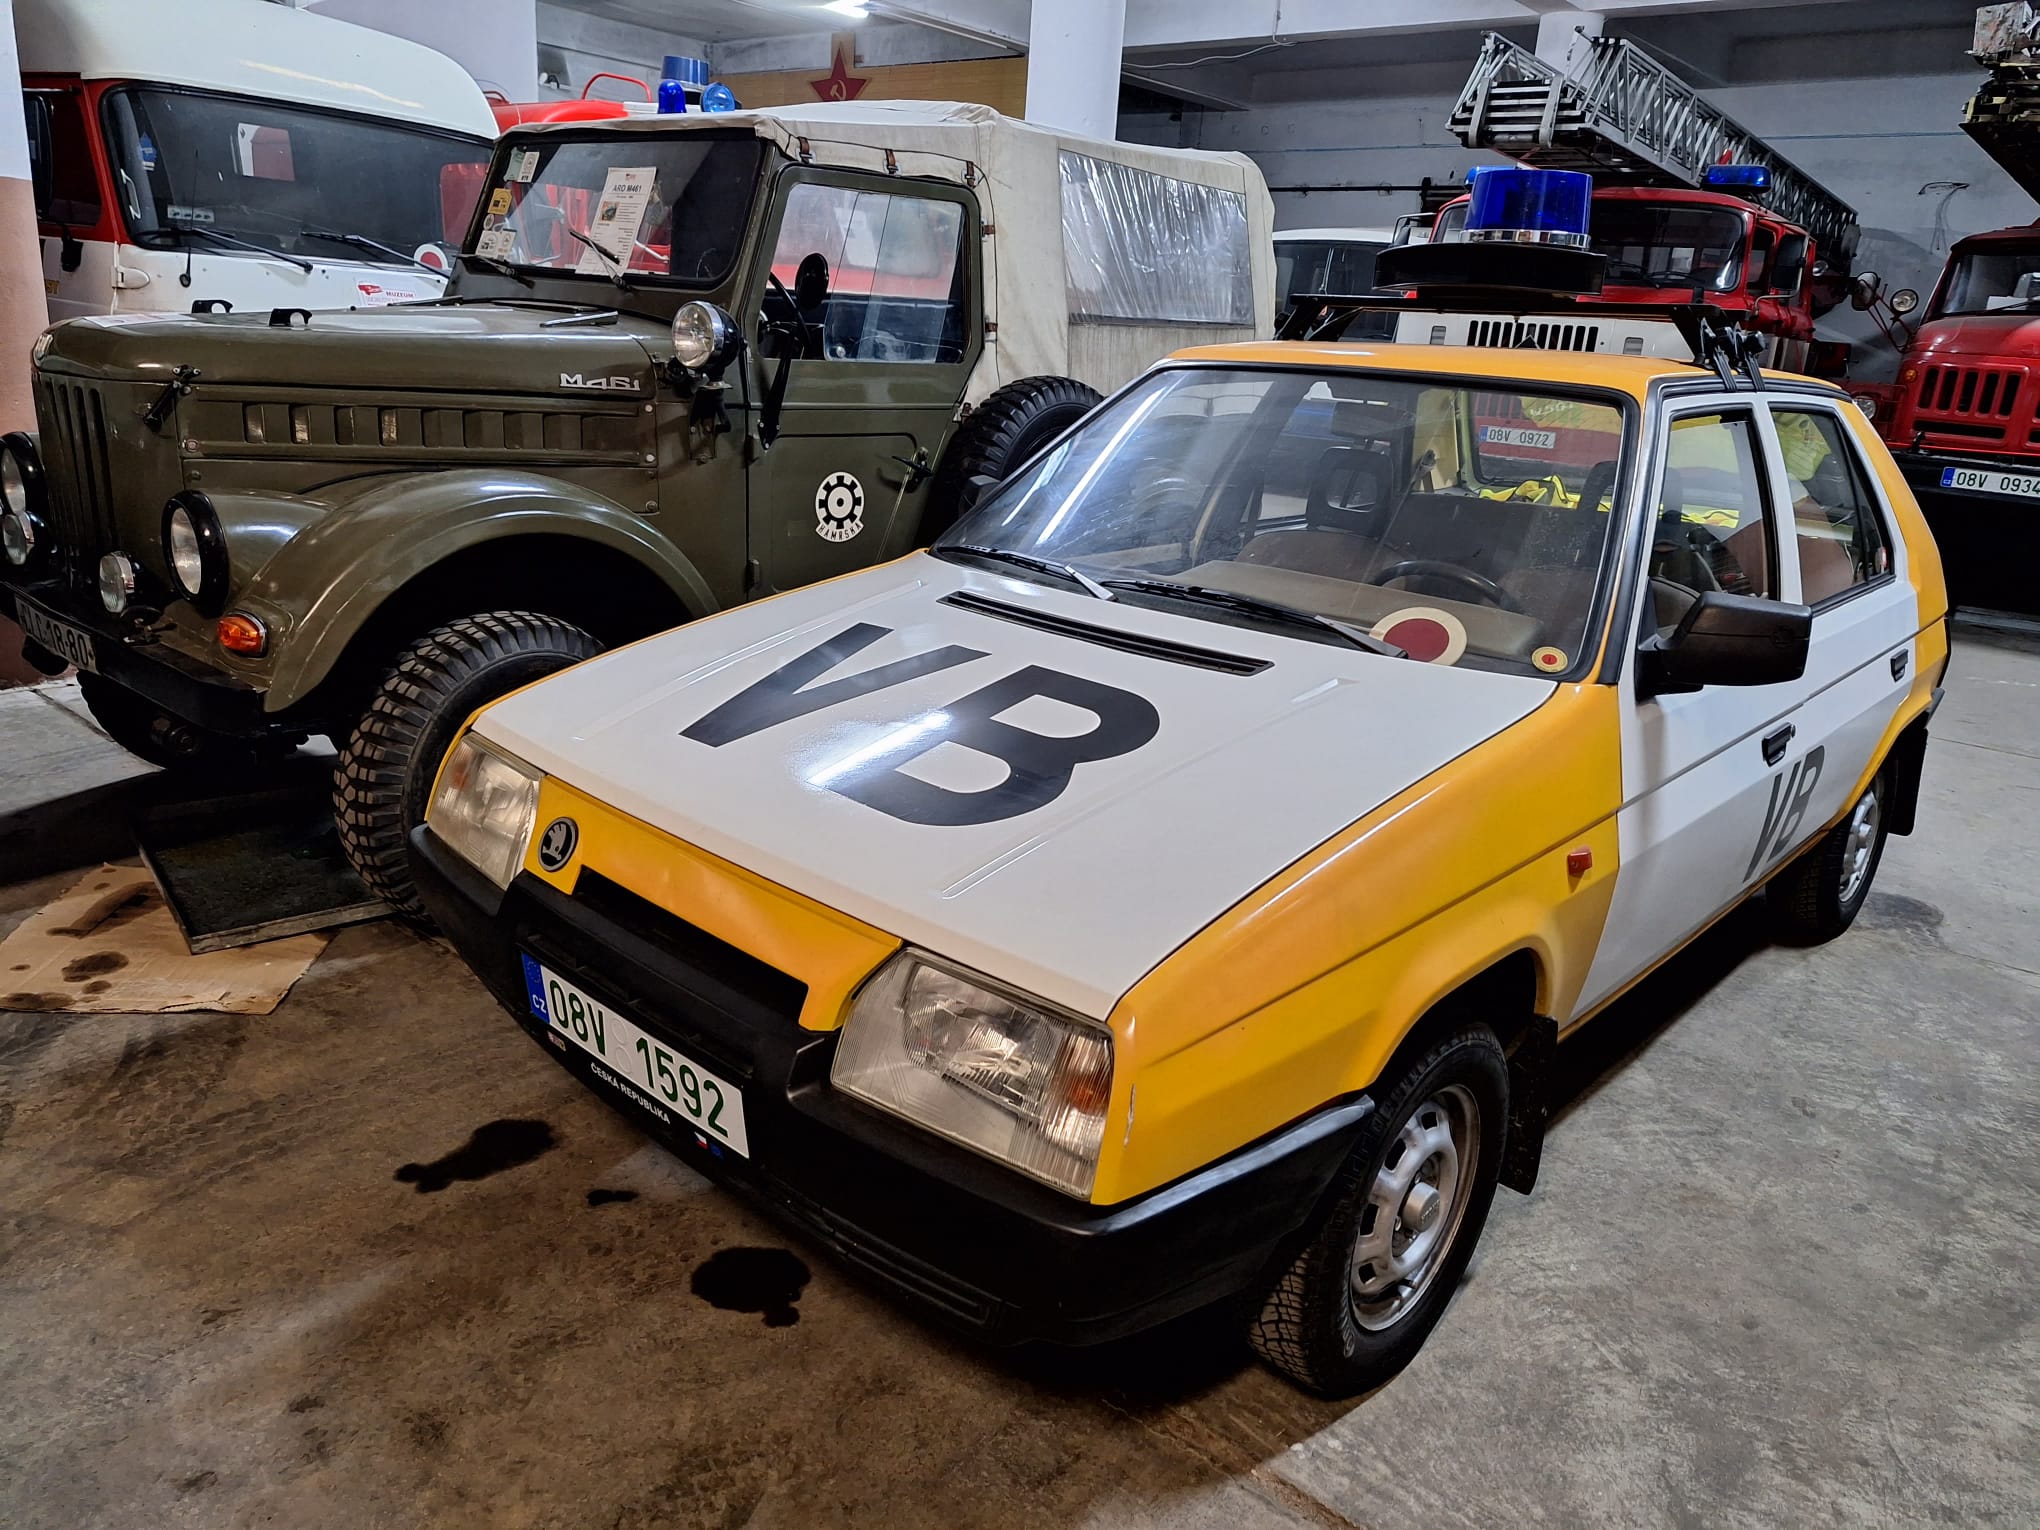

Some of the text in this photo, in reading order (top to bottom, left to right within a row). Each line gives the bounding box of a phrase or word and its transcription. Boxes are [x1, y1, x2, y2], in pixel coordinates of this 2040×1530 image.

[385, 290, 415, 299] MUZEUM
[1489, 428, 1550, 447] 08V 0972
[1956, 471, 2040, 495] 08V 0934
[678, 622, 1160, 826] VB
[1743, 744, 1826, 884] VB
[532, 994, 547, 1014] CZ
[550, 979, 729, 1138] 08V 1592
[590, 1061, 671, 1125] ČESKÁ REPUBLIKA
